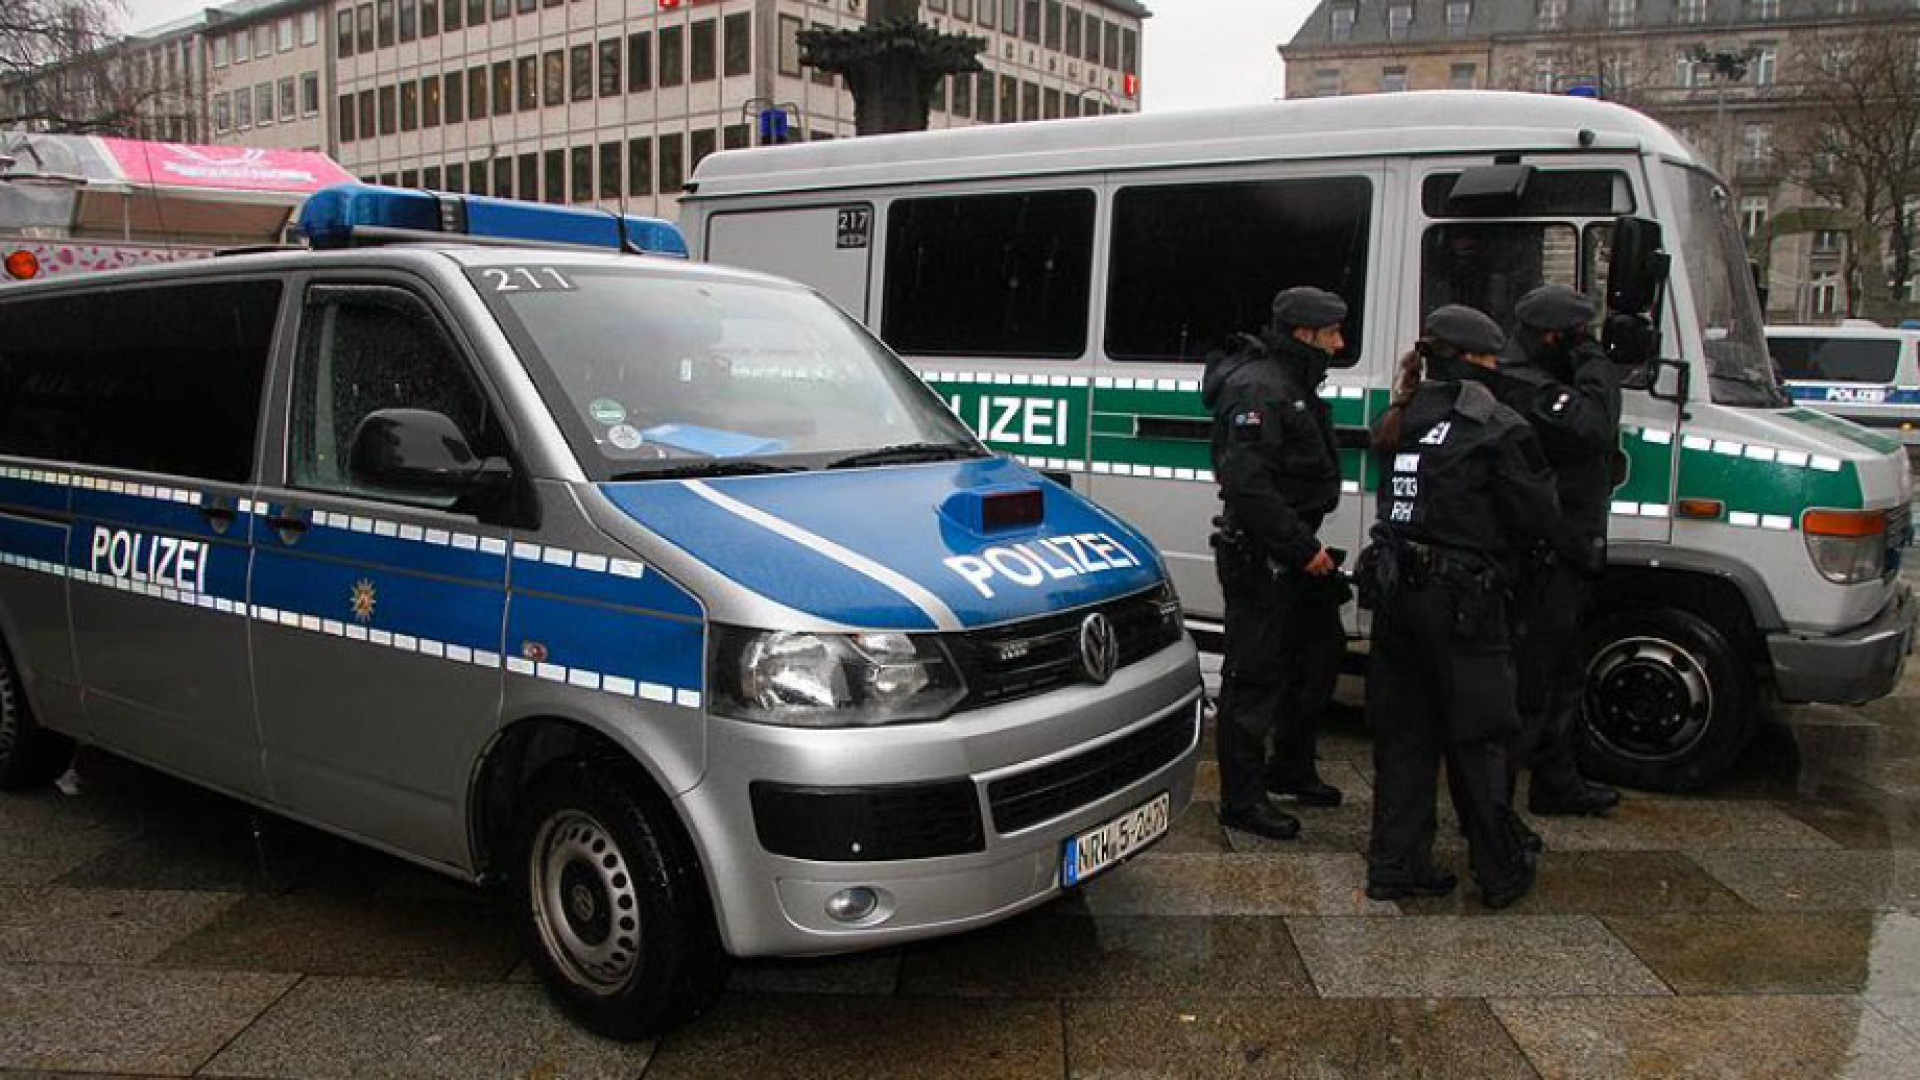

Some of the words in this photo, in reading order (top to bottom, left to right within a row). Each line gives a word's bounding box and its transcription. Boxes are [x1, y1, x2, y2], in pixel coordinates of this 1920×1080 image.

[838, 212, 868, 229] 217
[482, 266, 569, 291] 211
[91, 526, 209, 593] POLIZEI
[943, 533, 1141, 599] POLIZEI
[1078, 827, 1111, 874] NRW
